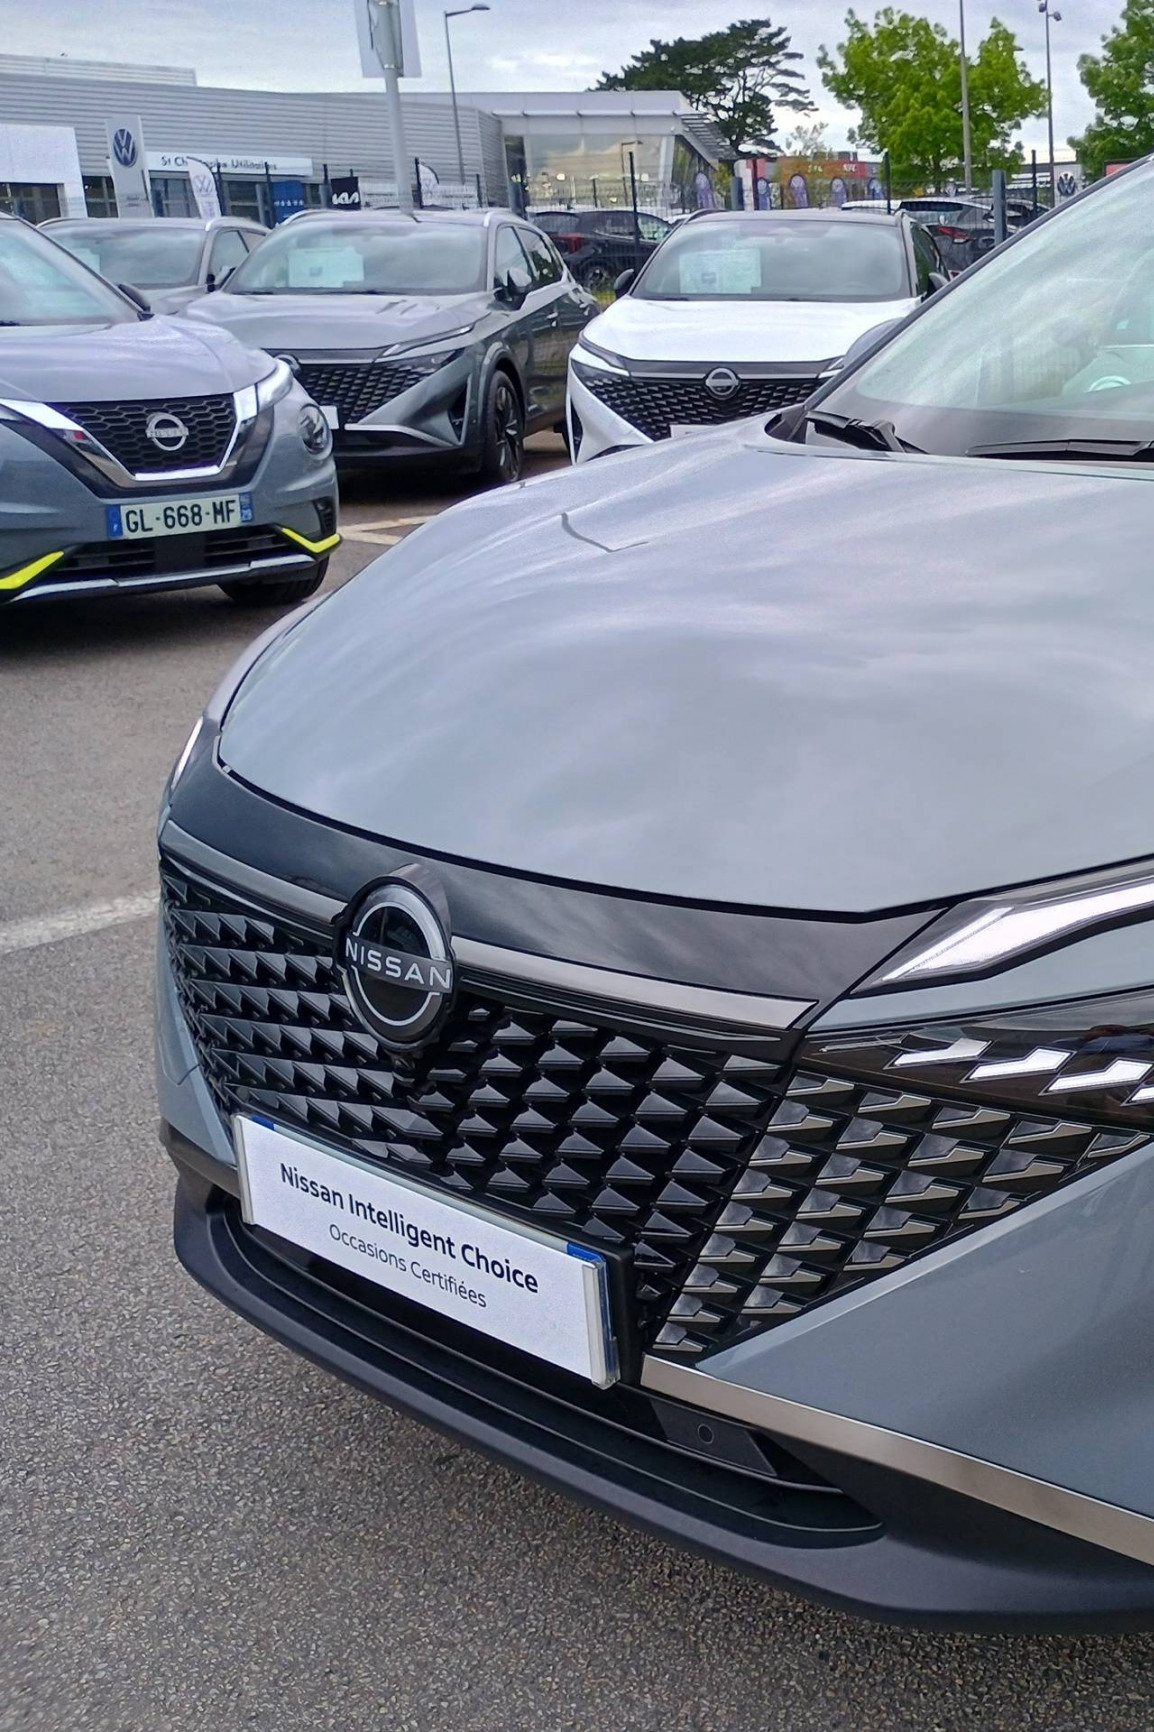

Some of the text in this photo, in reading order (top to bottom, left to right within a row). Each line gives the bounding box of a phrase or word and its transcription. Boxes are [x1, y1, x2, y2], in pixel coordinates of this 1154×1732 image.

[126, 500, 236, 533] GL-668-MF
[345, 937, 451, 989] NISSAN
[280, 1162, 539, 1294] Nissan Intelligent Choice
[329, 1223, 487, 1308] Occasions Certifiées
